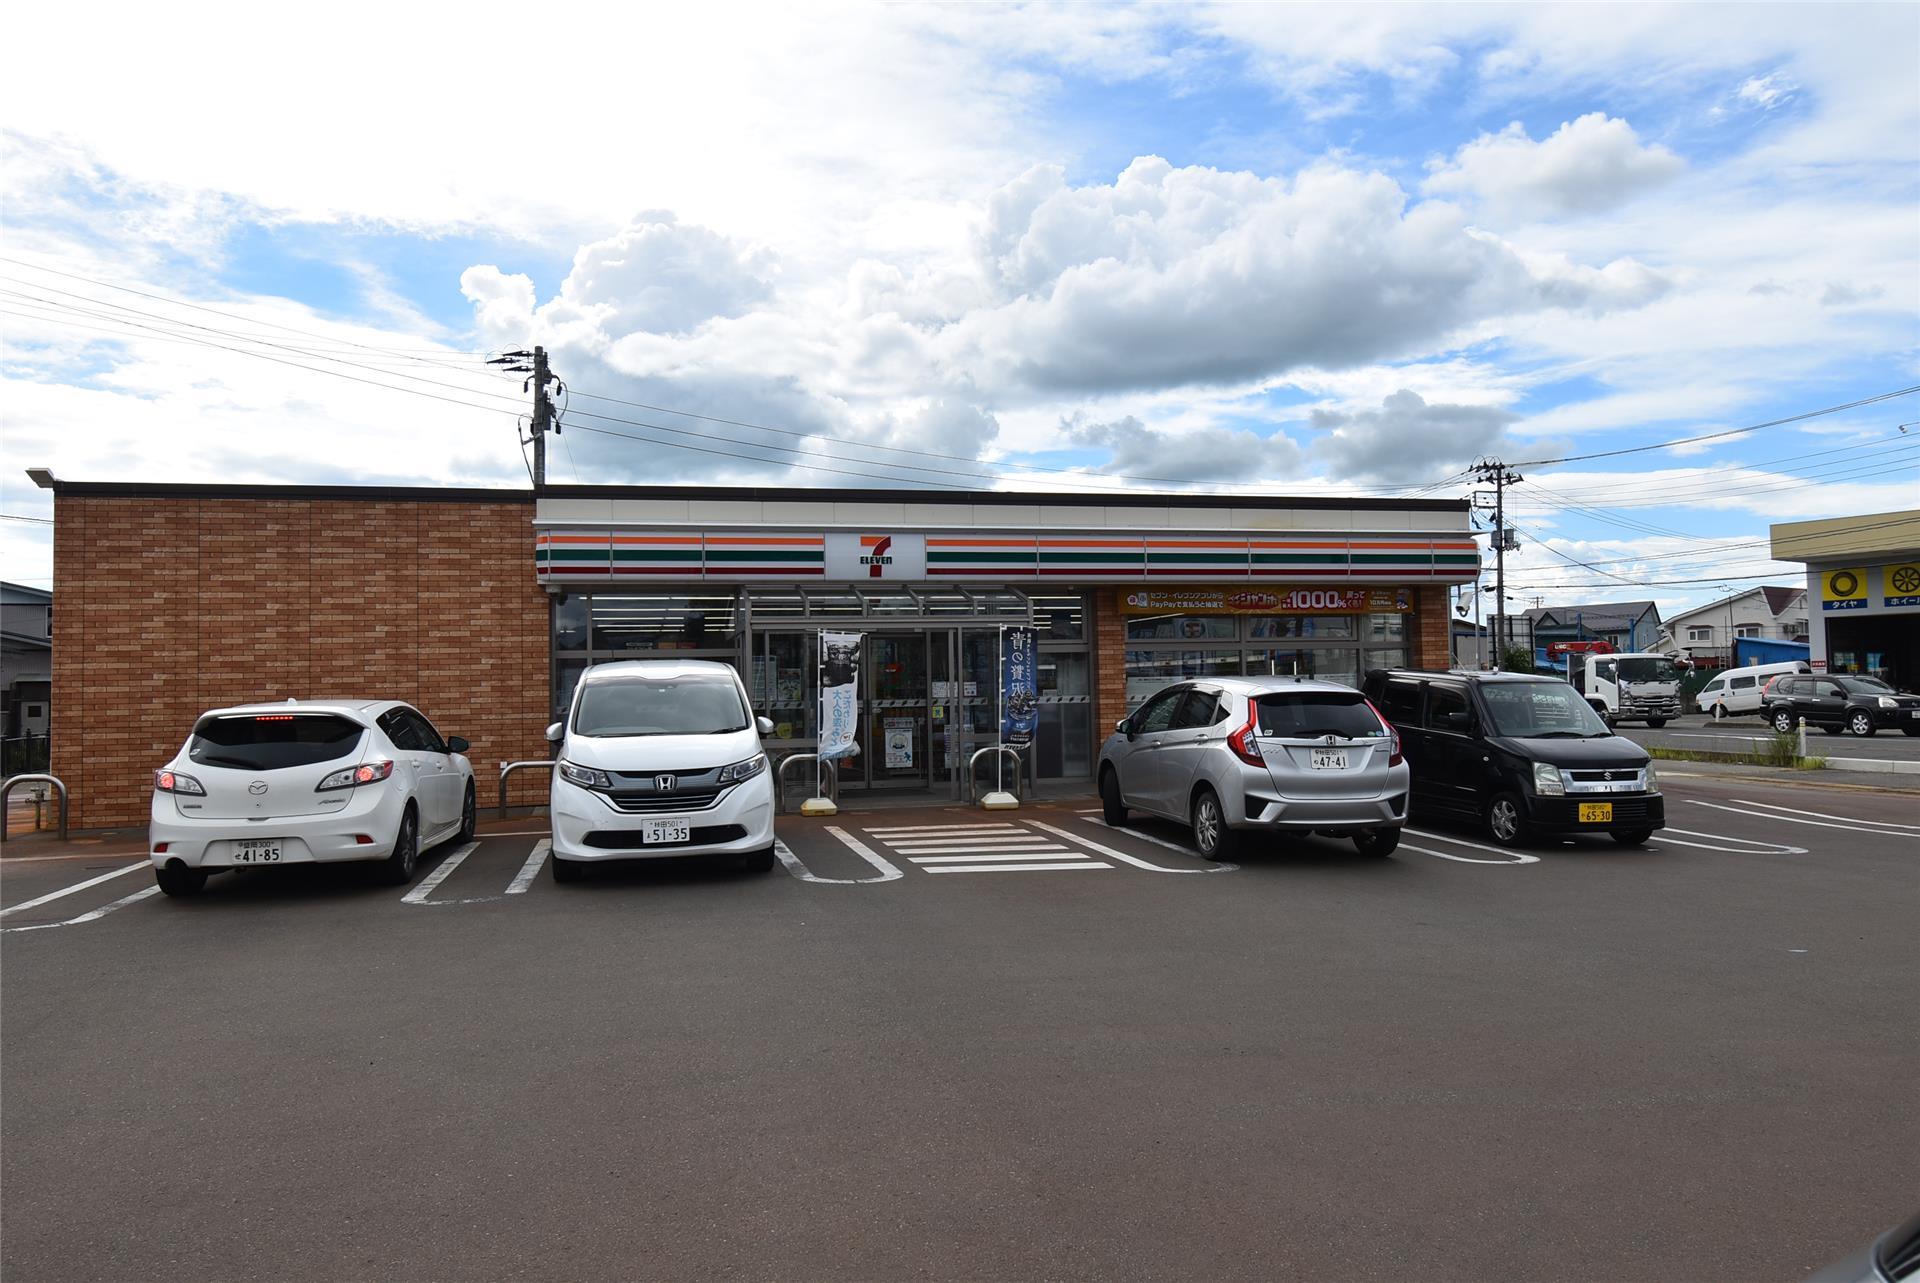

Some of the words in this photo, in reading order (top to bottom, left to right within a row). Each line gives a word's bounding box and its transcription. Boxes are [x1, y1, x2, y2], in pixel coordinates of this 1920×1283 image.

[1832, 600, 1858, 609] タイヤ
[1319, 756, 1346, 767] 47-41
[1586, 810, 1611, 821] 65-30
[653, 827, 687, 841] 51-35
[242, 848, 280, 862] 41-85
